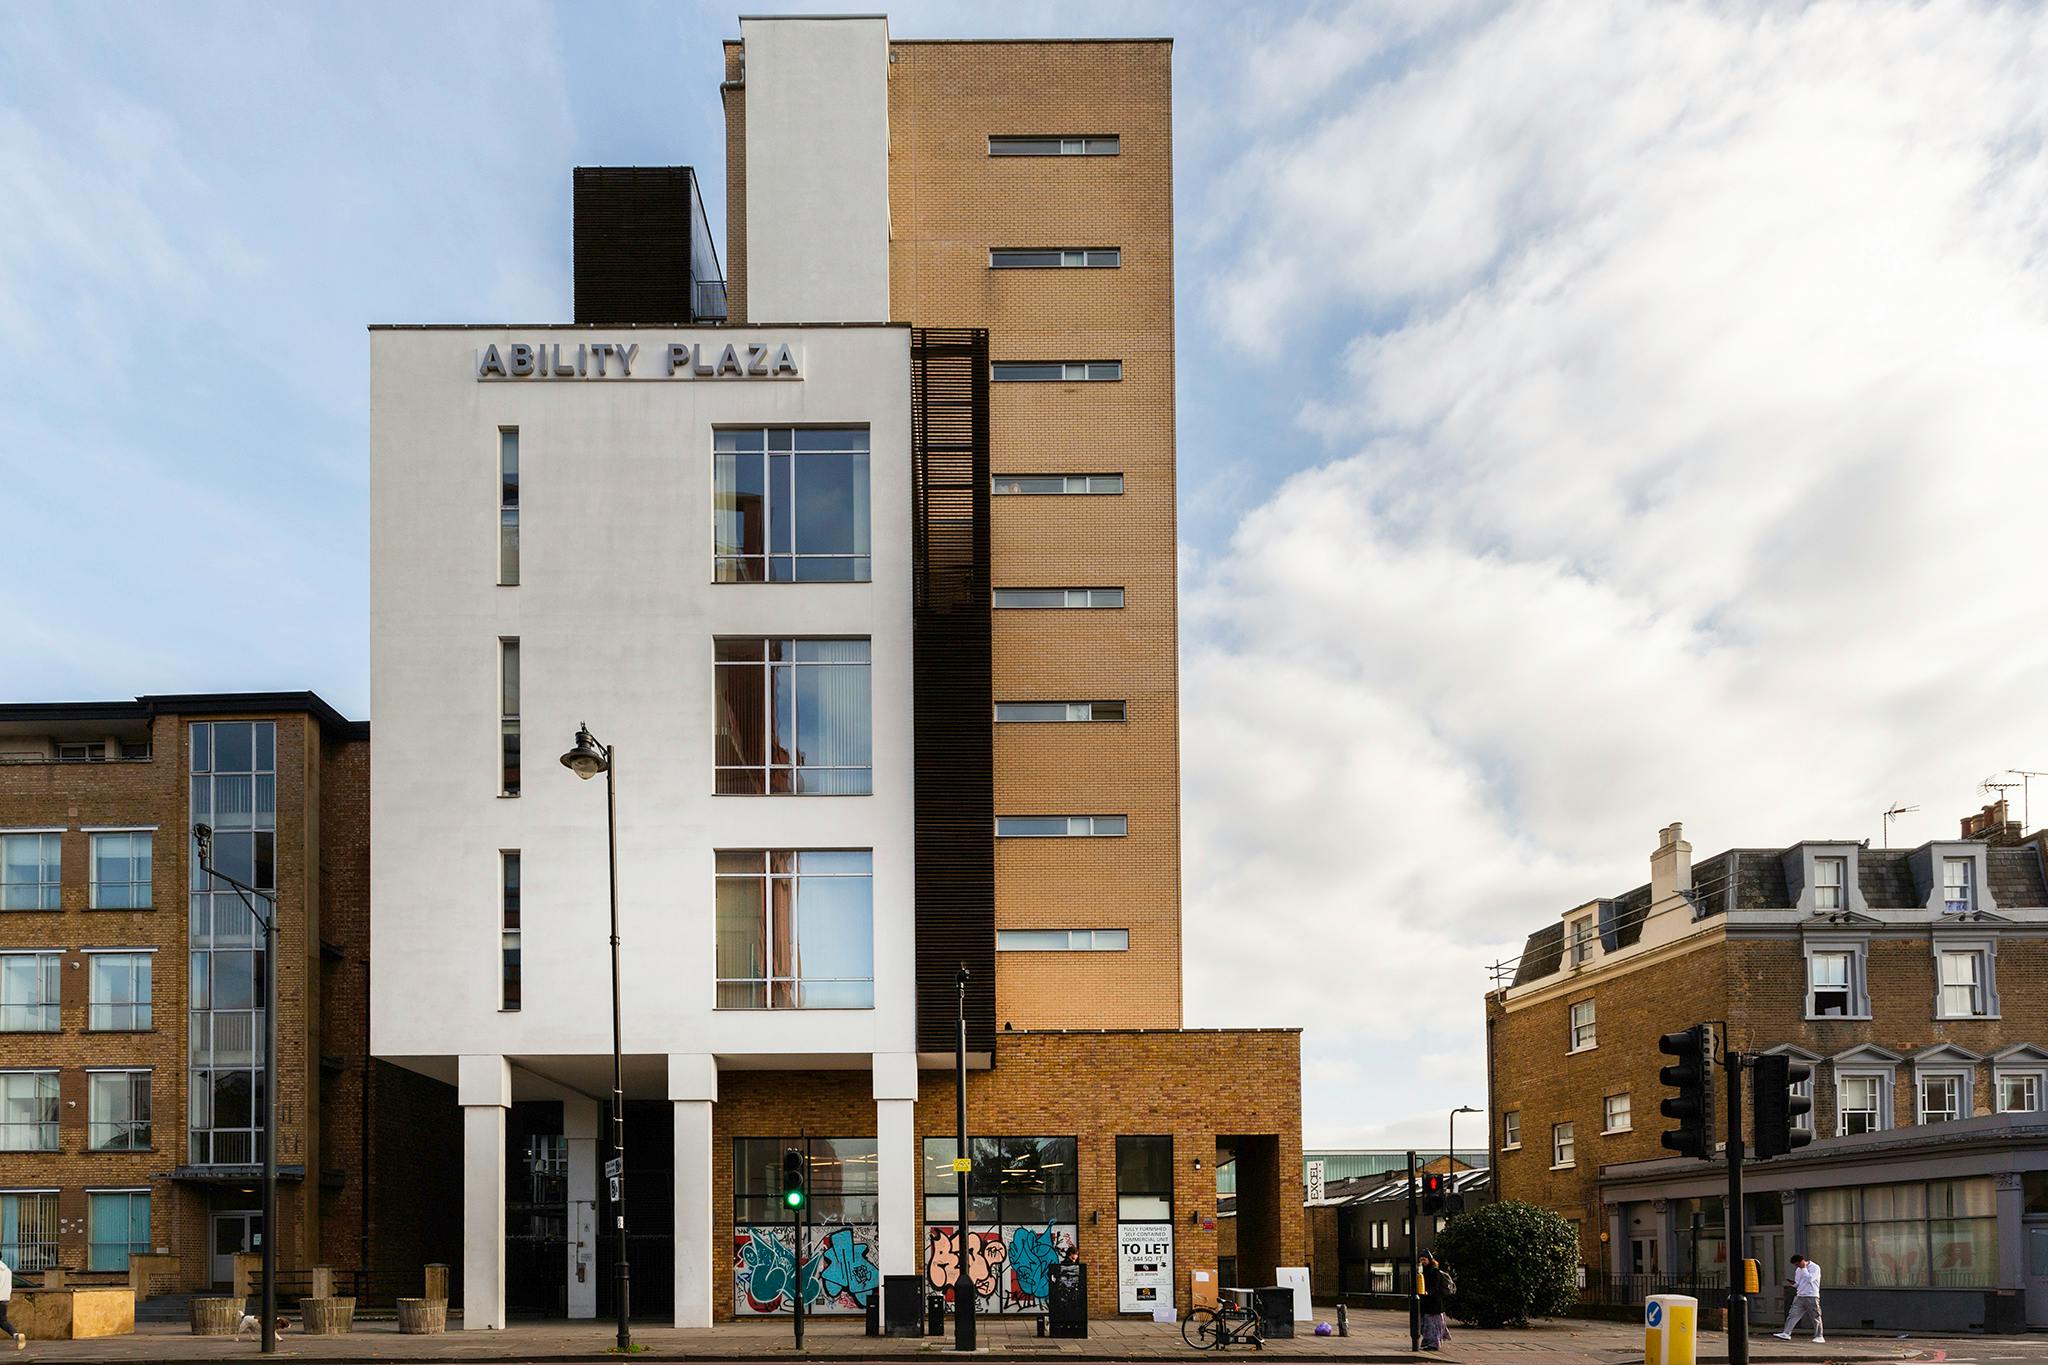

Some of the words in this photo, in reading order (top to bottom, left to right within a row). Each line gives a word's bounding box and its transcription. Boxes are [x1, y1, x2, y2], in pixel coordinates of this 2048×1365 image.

[479, 343, 639, 377] ABILITY
[667, 343, 798, 377] PLAZA
[1309, 1163, 1319, 1200] EXCEL
[1121, 1243, 1140, 1254] TO
[1145, 1243, 1169, 1254] LET
